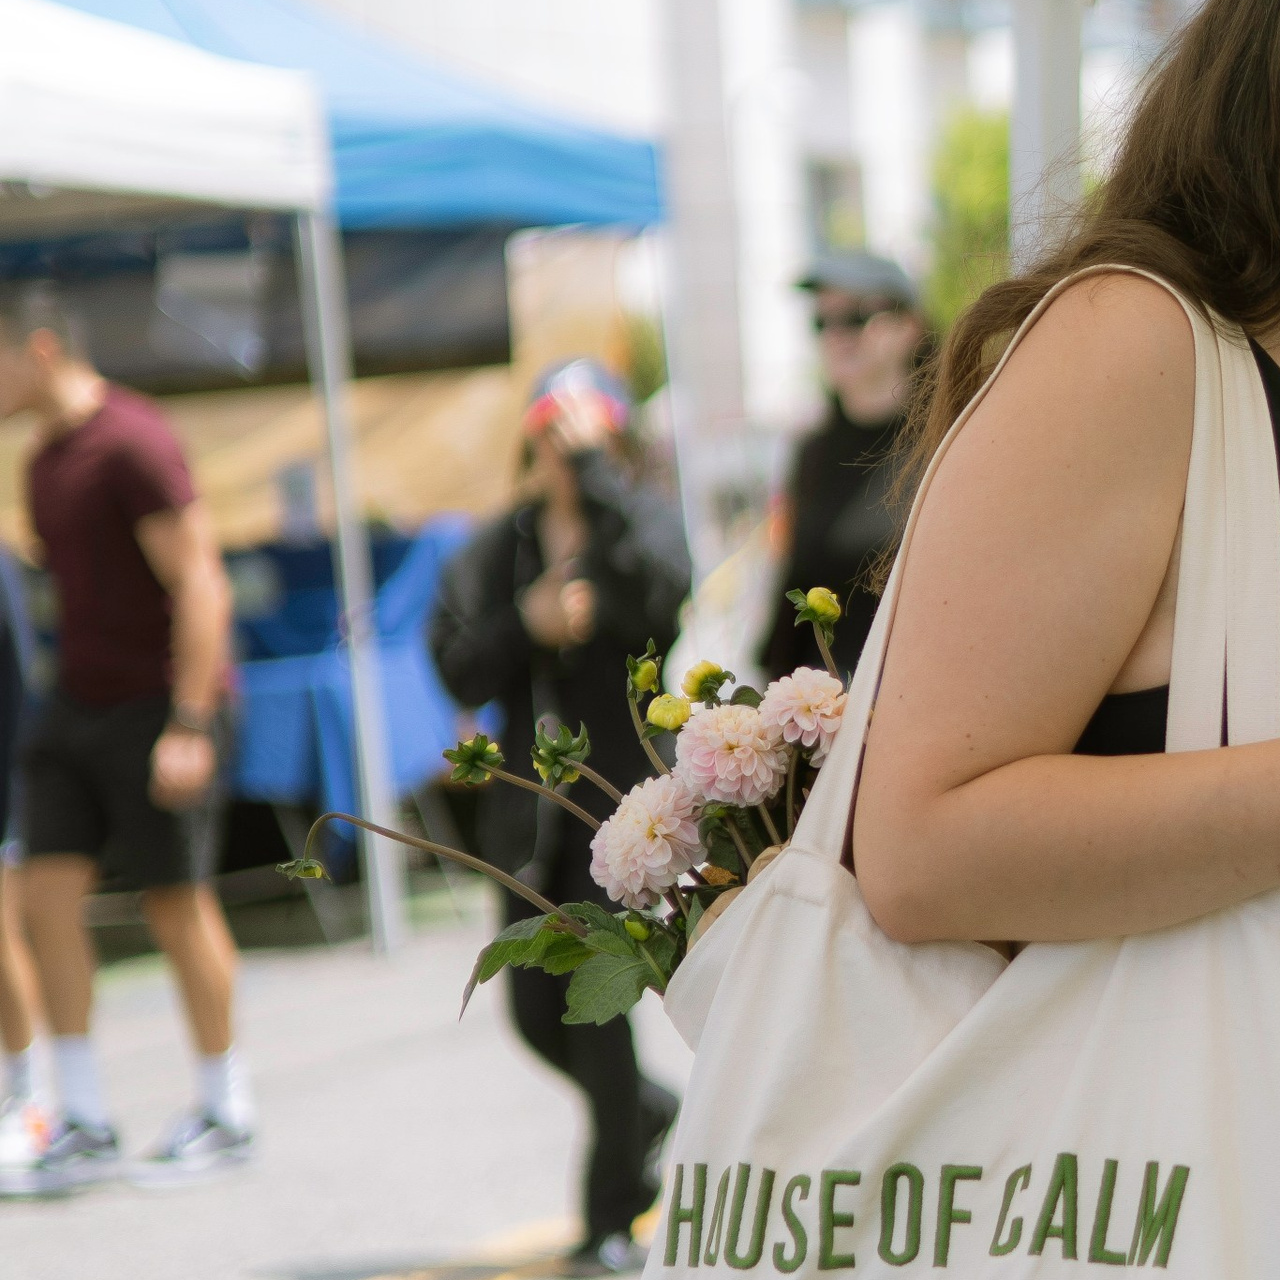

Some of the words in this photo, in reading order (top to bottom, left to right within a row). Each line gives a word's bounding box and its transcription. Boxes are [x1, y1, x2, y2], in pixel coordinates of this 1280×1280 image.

[663, 1162, 861, 1274] HOUSE
[877, 1162, 983, 1268] OF
[988, 1152, 1191, 1269] CALM
